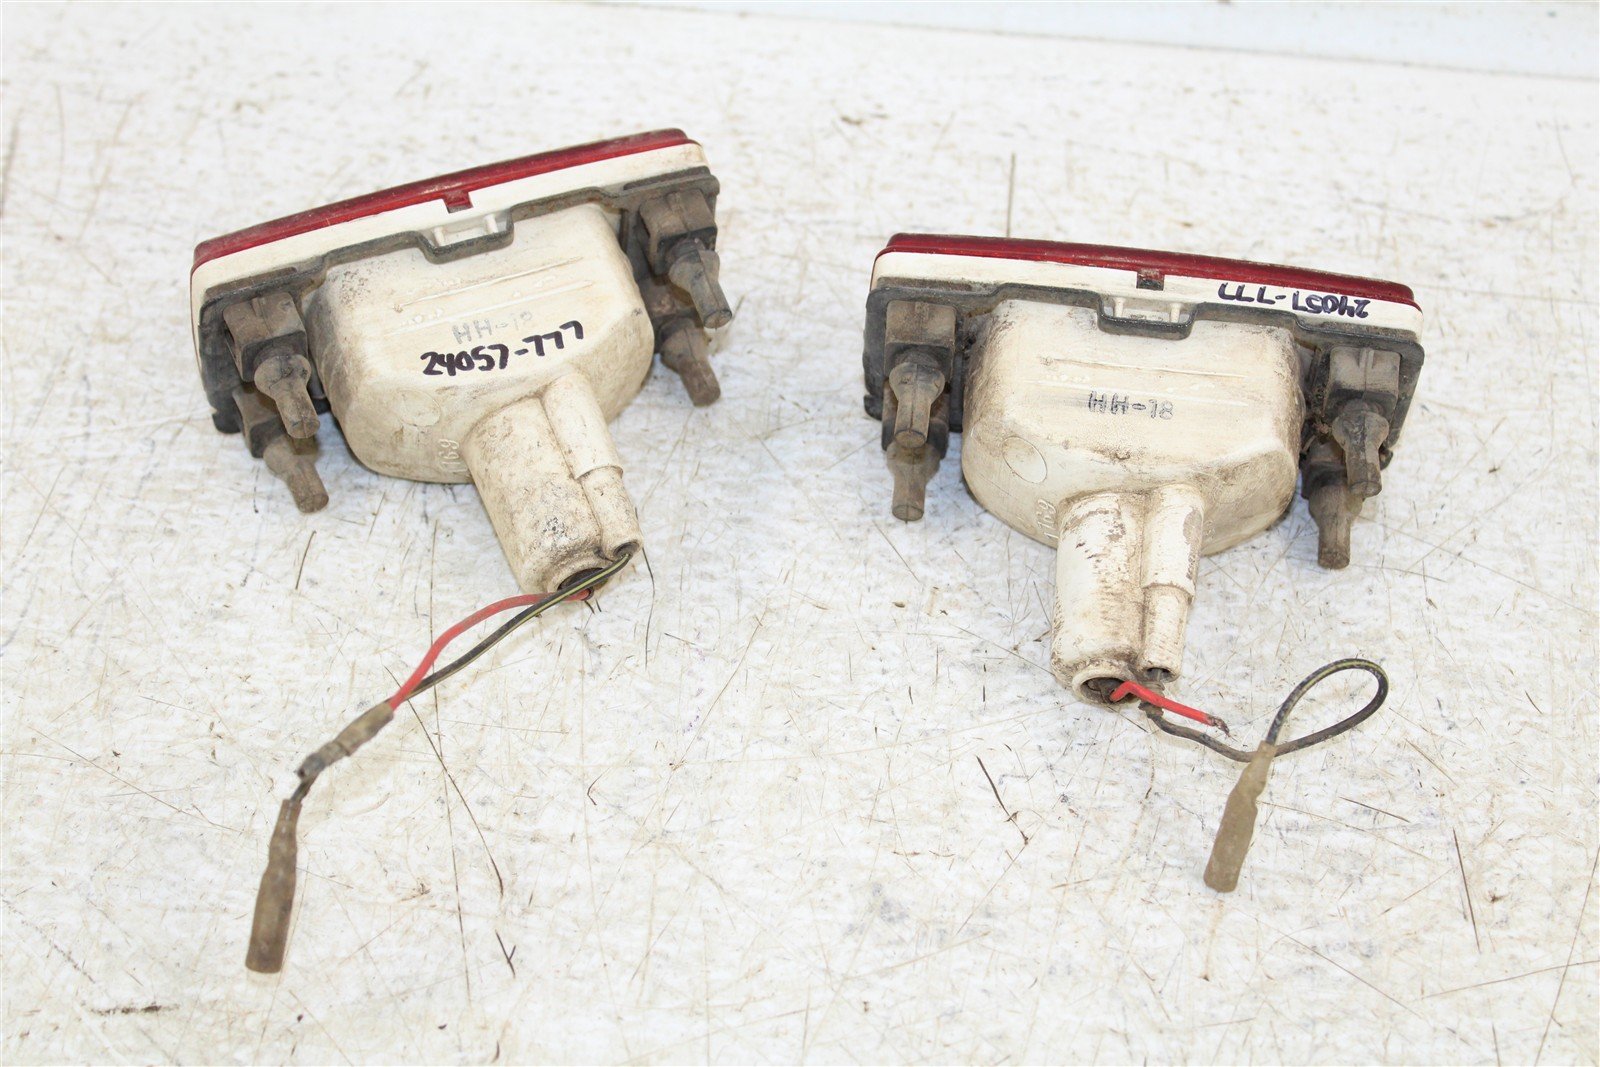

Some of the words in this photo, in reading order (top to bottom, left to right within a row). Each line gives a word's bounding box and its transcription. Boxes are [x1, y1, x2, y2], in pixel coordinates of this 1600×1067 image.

[1217, 282, 1371, 319] 24057-777
[420, 319, 584, 376] 24057-777
[1087, 390, 1174, 420] HH-18
